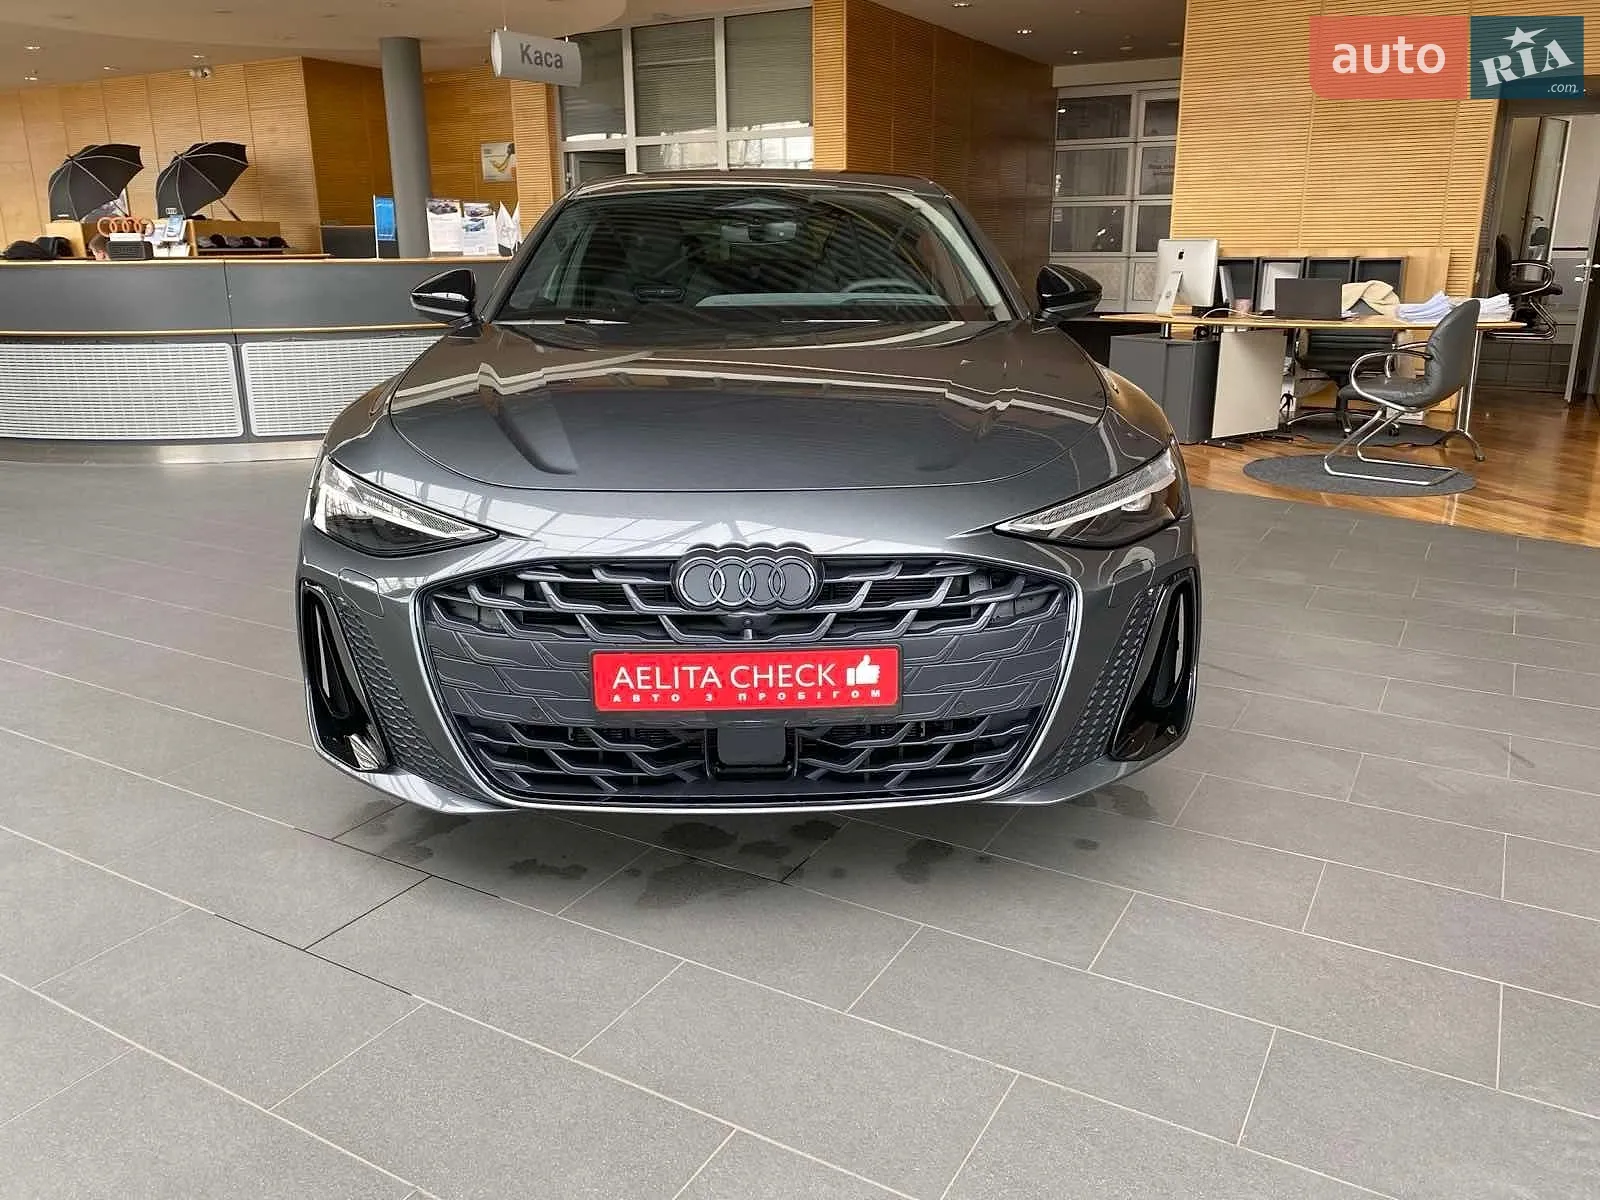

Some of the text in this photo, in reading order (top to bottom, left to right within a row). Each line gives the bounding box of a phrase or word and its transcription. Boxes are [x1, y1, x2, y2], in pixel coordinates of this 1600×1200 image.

[519, 42, 564, 69] Каса
[612, 663, 837, 690] AELITA CHECK
[612, 693, 681, 703] АВТО
[738, 689, 881, 702] ПРОБІГОМ
